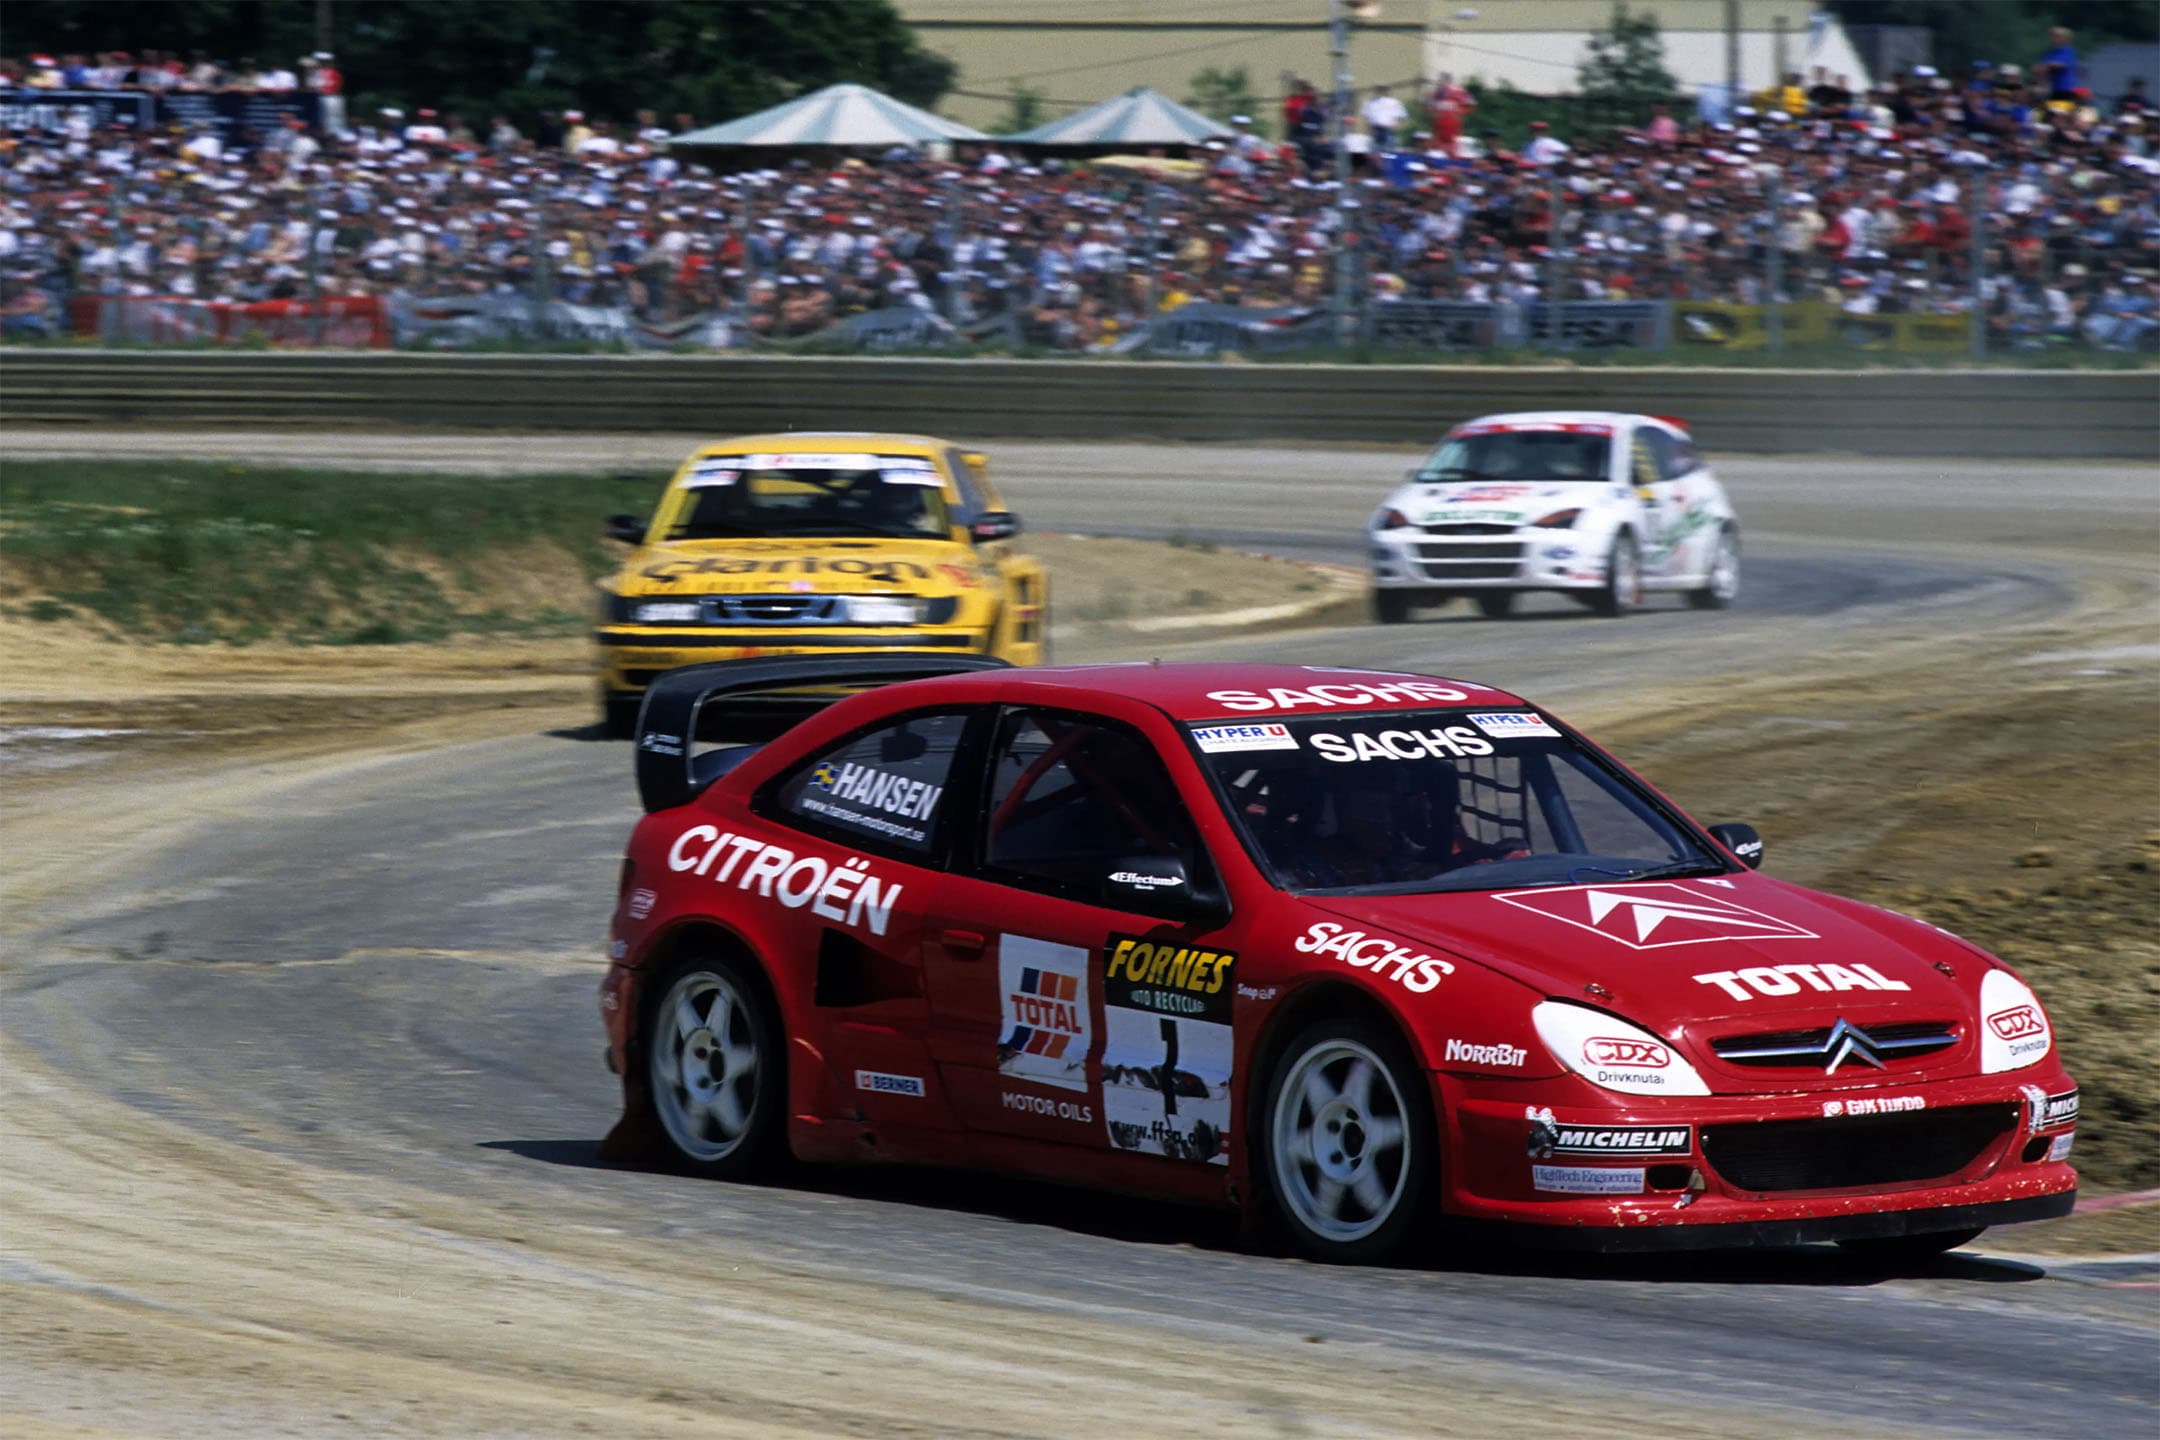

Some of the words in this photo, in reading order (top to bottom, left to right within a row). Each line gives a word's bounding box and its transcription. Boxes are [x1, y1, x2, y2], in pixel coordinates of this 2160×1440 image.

[1206, 681, 1468, 711] SACHS
[1192, 727, 1266, 740] HYPER
[1268, 726, 1285, 737] U
[1472, 715, 1528, 725] HYPER
[1525, 715, 1542, 725] U
[1310, 726, 1494, 763] SACHS
[831, 762, 943, 821] HANSEN
[668, 825, 903, 936] CITROËN
[1107, 940, 1234, 994] FORNES
[1295, 922, 1455, 993] SACHS
[1692, 963, 1911, 1001] TOTAL
[1010, 995, 1083, 1034] TOTAL
[1992, 1009, 2044, 1037] CDX
[1594, 1041, 1664, 1064] CDX
[1002, 1091, 1056, 1118] MOTOR
[1058, 1099, 1093, 1124] OILS
[1557, 1130, 1687, 1148] MICHELIN
